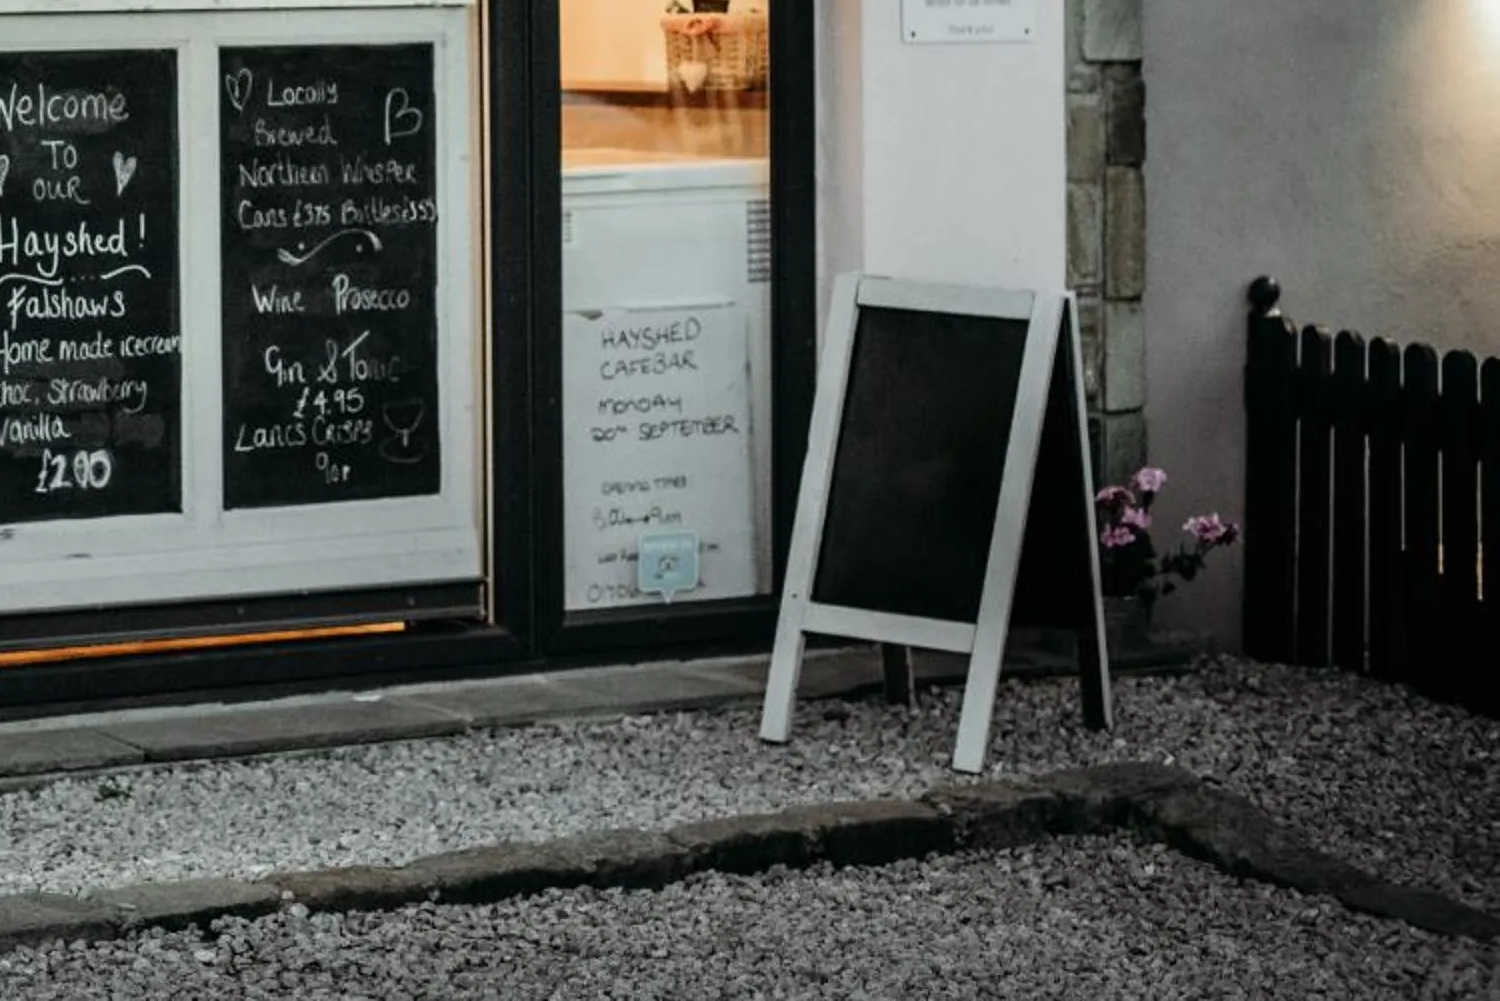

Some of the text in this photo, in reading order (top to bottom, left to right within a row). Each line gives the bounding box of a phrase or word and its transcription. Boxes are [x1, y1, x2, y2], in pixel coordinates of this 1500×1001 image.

[266, 79, 339, 106] Locally
[255, 113, 339, 147] Brewed
[239, 157, 330, 189] Northern
[239, 199, 288, 230] Cans
[7, 284, 126, 331] Falshaws
[252, 274, 411, 316] Wine Prosecco
[59, 331, 116, 360] made
[601, 318, 702, 351] HAYSHED
[264, 344, 307, 388] Gin
[341, 330, 402, 383] Tonic
[47, 376, 148, 415] Strawberry
[292, 385, 367, 420] £4.95
[234, 423, 308, 453] Lancs
[638, 413, 741, 442] SEPTEMBER
